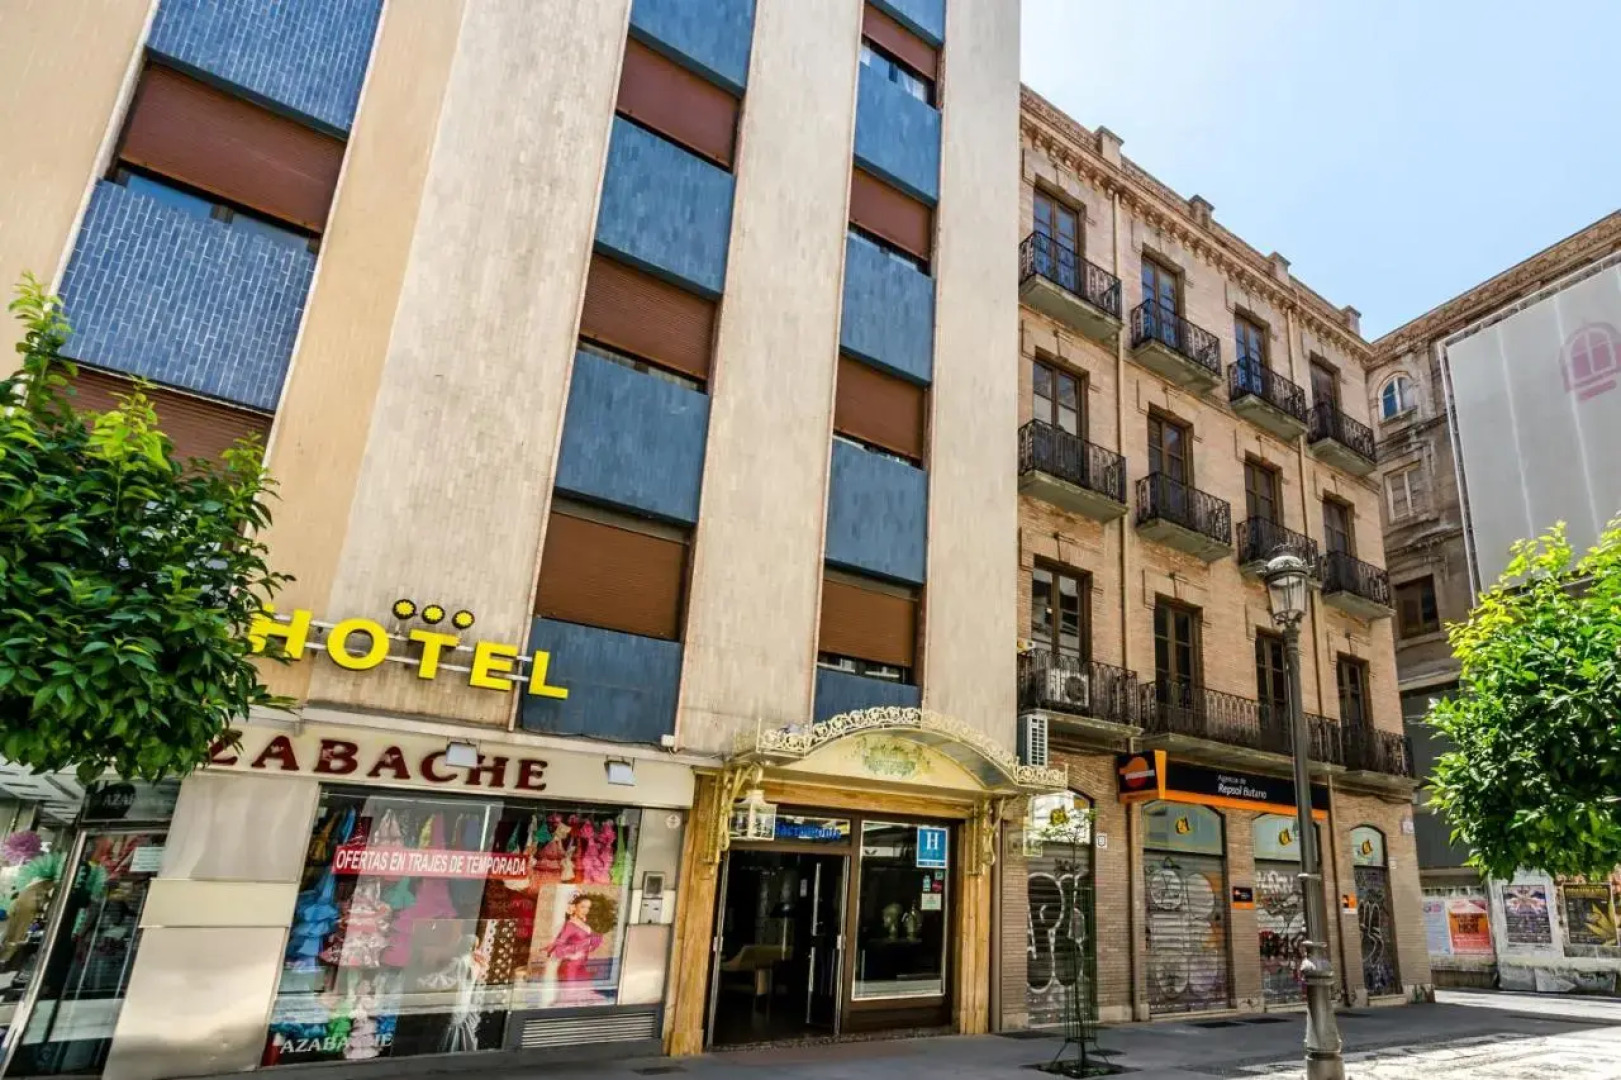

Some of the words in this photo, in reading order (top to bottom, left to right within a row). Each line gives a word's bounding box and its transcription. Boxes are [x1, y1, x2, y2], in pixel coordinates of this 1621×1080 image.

[249, 603, 569, 700] HOTEL
[206, 728, 549, 791] ZABACHE
[1217, 783, 1242, 796] Repsol
[1243, 786, 1267, 799] Butano
[926, 832, 938, 850] H
[335, 850, 387, 869] OFERTAS
[389, 852, 405, 870] EN
[408, 853, 447, 873] TRAJES
[449, 855, 463, 873] DE
[466, 856, 526, 876] TEMPORADA
[280, 1033, 393, 1054] AZABAE
